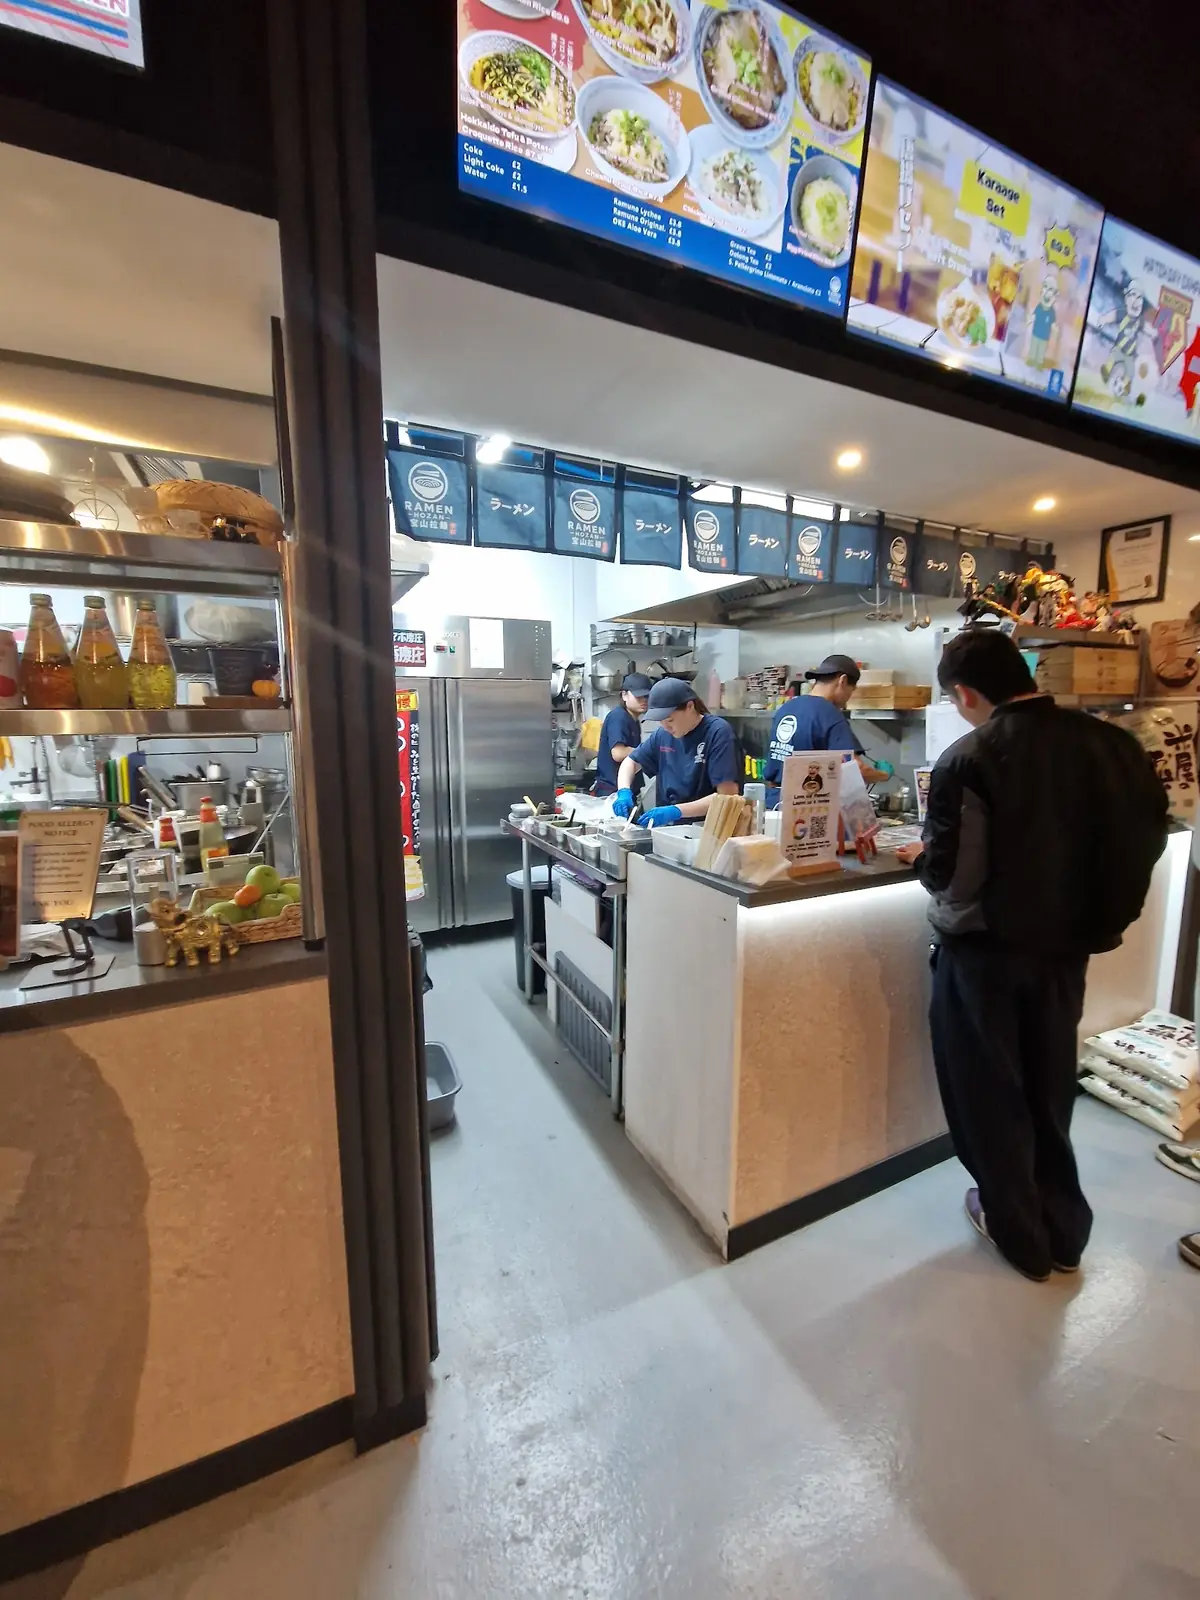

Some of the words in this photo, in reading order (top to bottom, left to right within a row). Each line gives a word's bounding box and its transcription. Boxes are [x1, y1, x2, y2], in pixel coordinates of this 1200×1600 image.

[460, 112, 500, 134] Hokkaido
[501, 127, 519, 141] Tofu
[526, 138, 553, 154] Potato
[462, 125, 504, 147] Croquette
[505, 142, 523, 154] Rice
[463, 142, 483, 156] Coke
[511, 160, 521, 170] £2
[463, 153, 484, 167] Light
[486, 162, 504, 175] Coke
[512, 171, 521, 181] £2
[463, 165, 488, 180] Water
[511, 182, 527, 194] £1.5
[976, 168, 1020, 204] Karaage
[613, 197, 639, 213] Ramune
[640, 207, 661, 221] Lychee
[613, 207, 638, 222] Ramune
[986, 198, 1005, 219] Set
[627, 222, 641, 234] Aloe
[642, 228, 657, 239] Vera
[729, 240, 746, 253] Green
[747, 246, 756, 256] Tea
[750, 256, 759, 265] Tea
[404, 500, 453, 515] RAMEN
[490, 497, 535, 516] ラーメン
[568, 521, 606, 535] RAMEN
[635, 519, 672, 535] ラーメン
[693, 540, 723, 552] RAMEN
[748, 534, 780, 549] ラーメン
[796, 554, 820, 565] RAMEN
[845, 548, 871, 561] ラーメン
[927, 559, 949, 572] ラーメン
[770, 741, 794, 753] RAMEN
[792, 818, 808, 840] G
